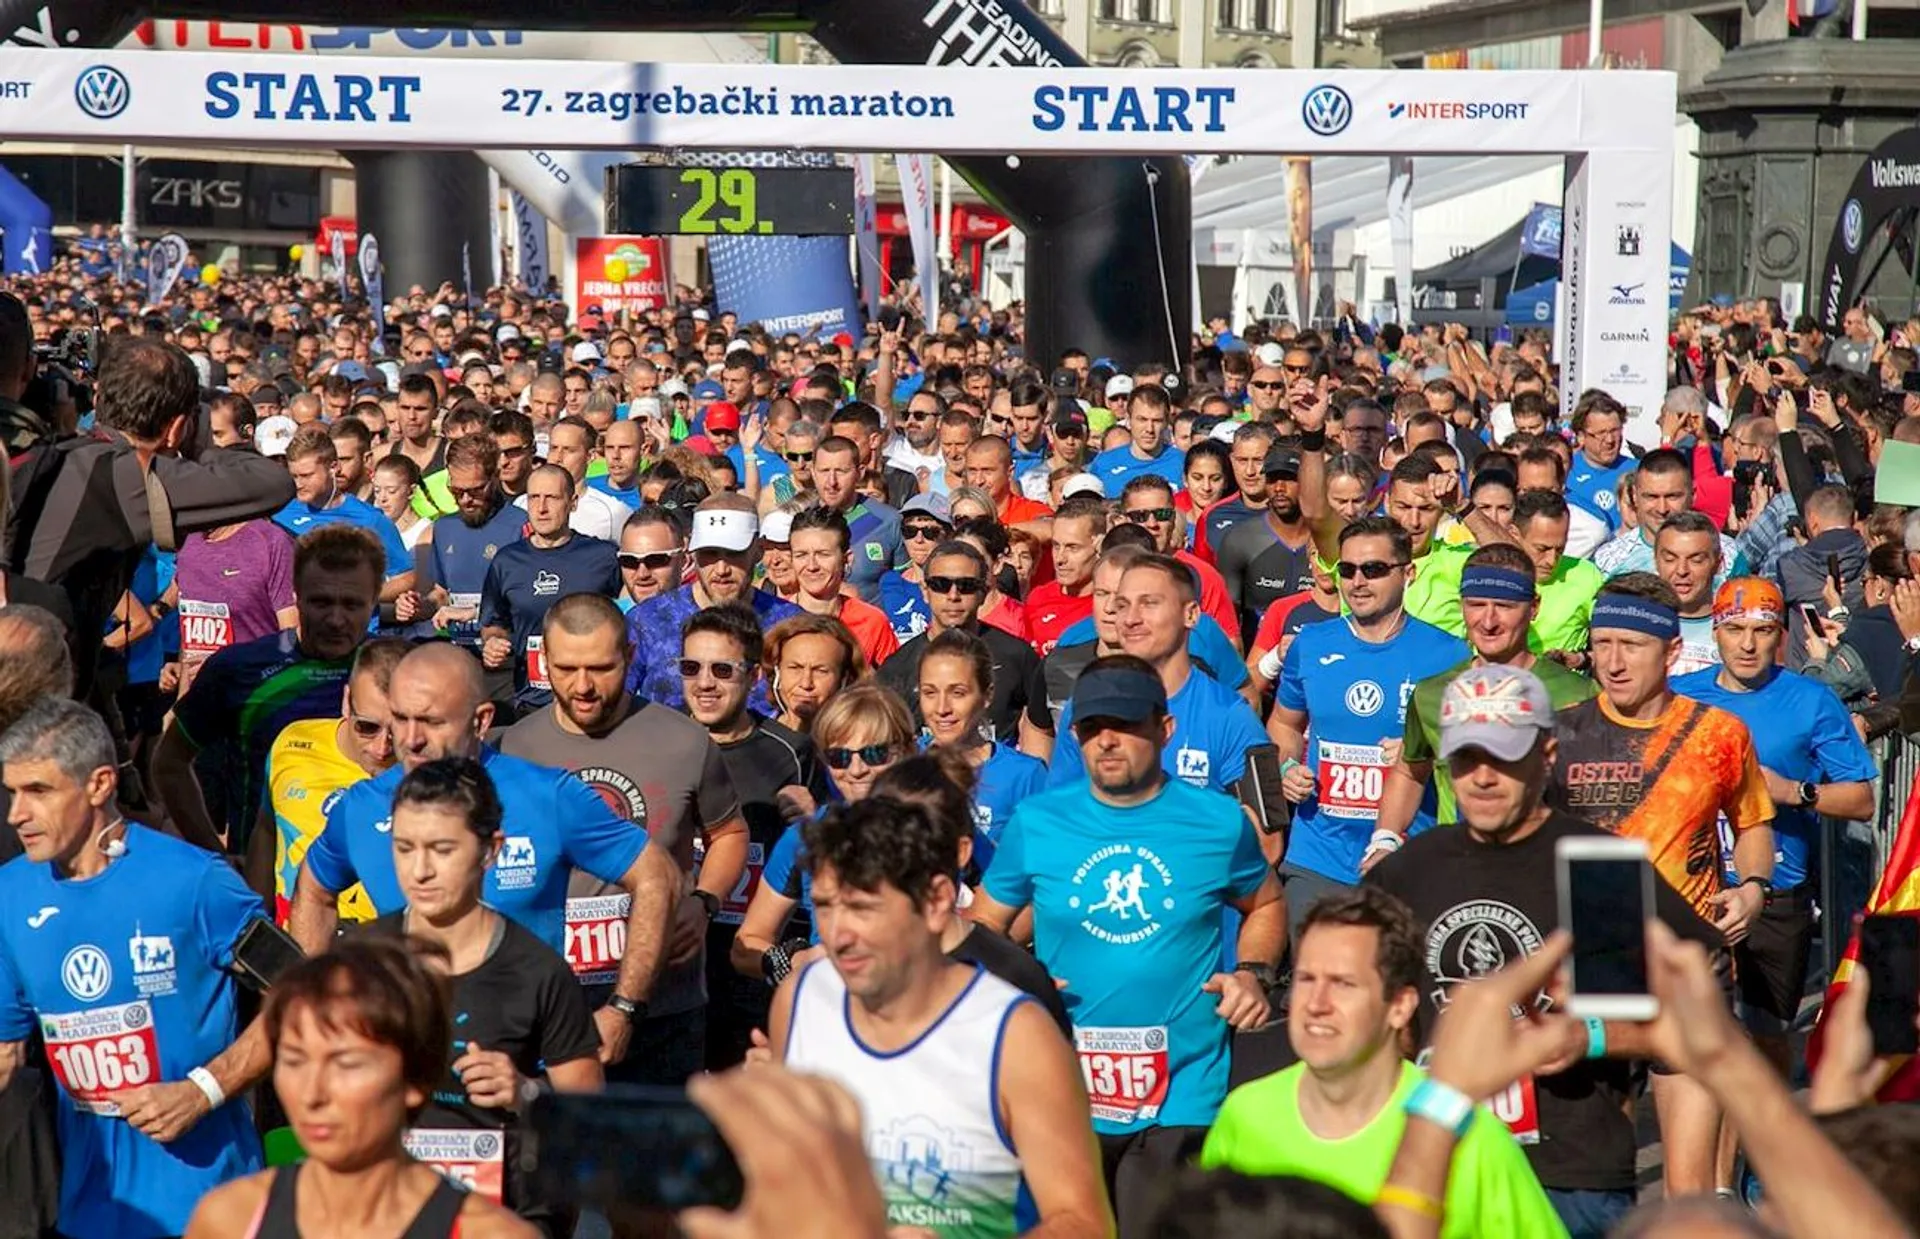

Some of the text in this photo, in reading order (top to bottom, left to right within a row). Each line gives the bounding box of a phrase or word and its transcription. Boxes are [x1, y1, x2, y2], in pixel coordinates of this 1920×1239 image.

[205, 71, 421, 122] START
[501, 86, 955, 121] 27. zagrebački maraton
[1032, 84, 1236, 133] START
[1406, 103, 1529, 120] INTERSPORT
[150, 177, 243, 208] ZAKS
[679, 169, 774, 234] 29.
[1600, 332, 1650, 342] GARMIN
[182, 617, 229, 647] 1402
[1329, 764, 1384, 802] 280
[53, 1034, 150, 1092] 1063
[1080, 1054, 1157, 1100] 1315
[887, 1202, 974, 1226] AKSIMIR
